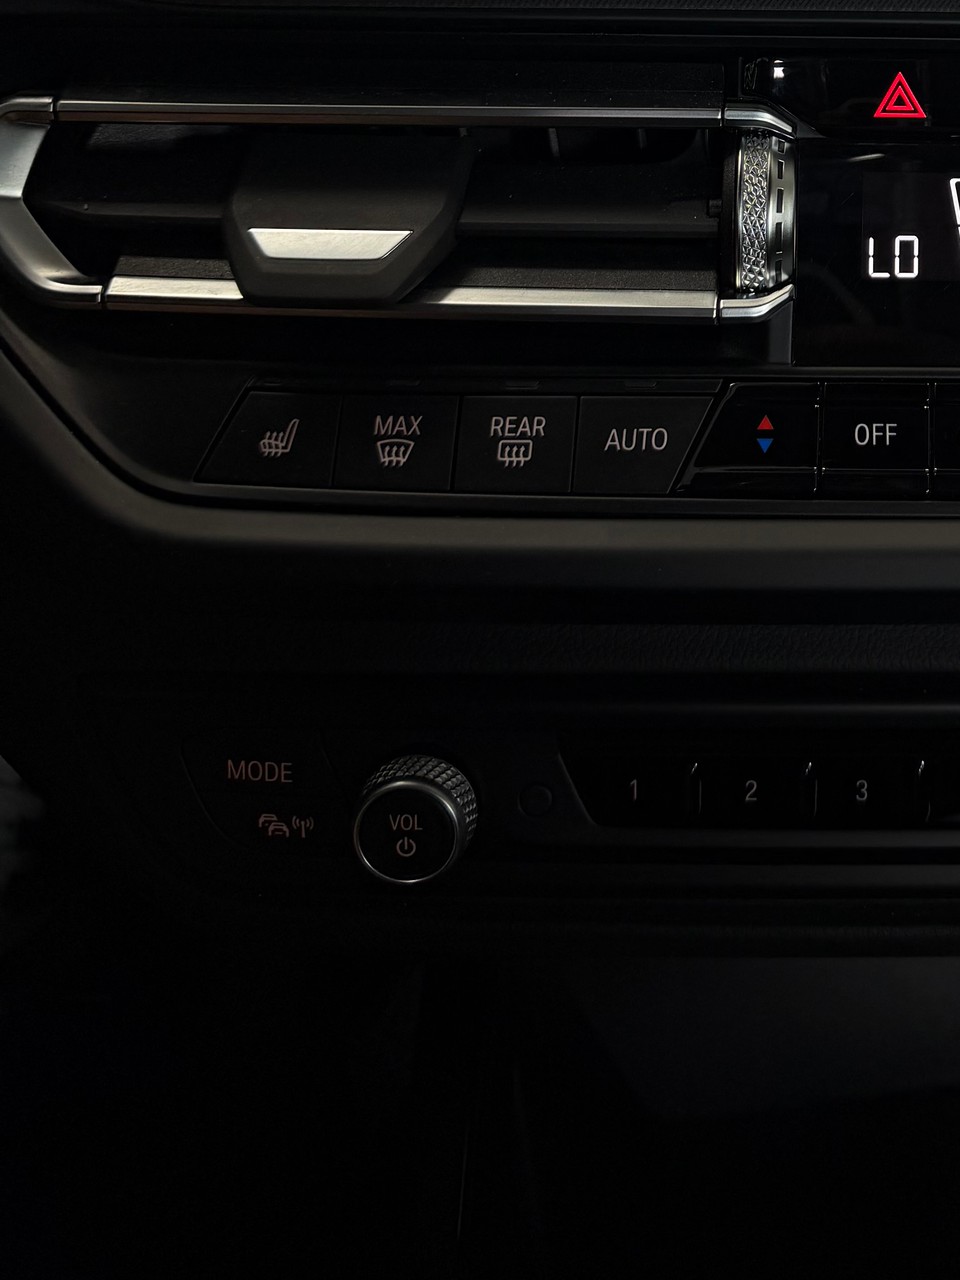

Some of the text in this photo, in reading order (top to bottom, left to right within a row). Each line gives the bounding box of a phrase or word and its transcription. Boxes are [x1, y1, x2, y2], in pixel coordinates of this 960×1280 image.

[868, 235, 919, 279] LO
[374, 415, 423, 436] MAX
[490, 416, 547, 437] REAR
[854, 423, 898, 446] OFF
[604, 427, 669, 452] AUTO
[227, 759, 293, 783] MODE
[745, 779, 758, 801] 2
[856, 779, 868, 801] 3
[389, 814, 423, 831] VOL
